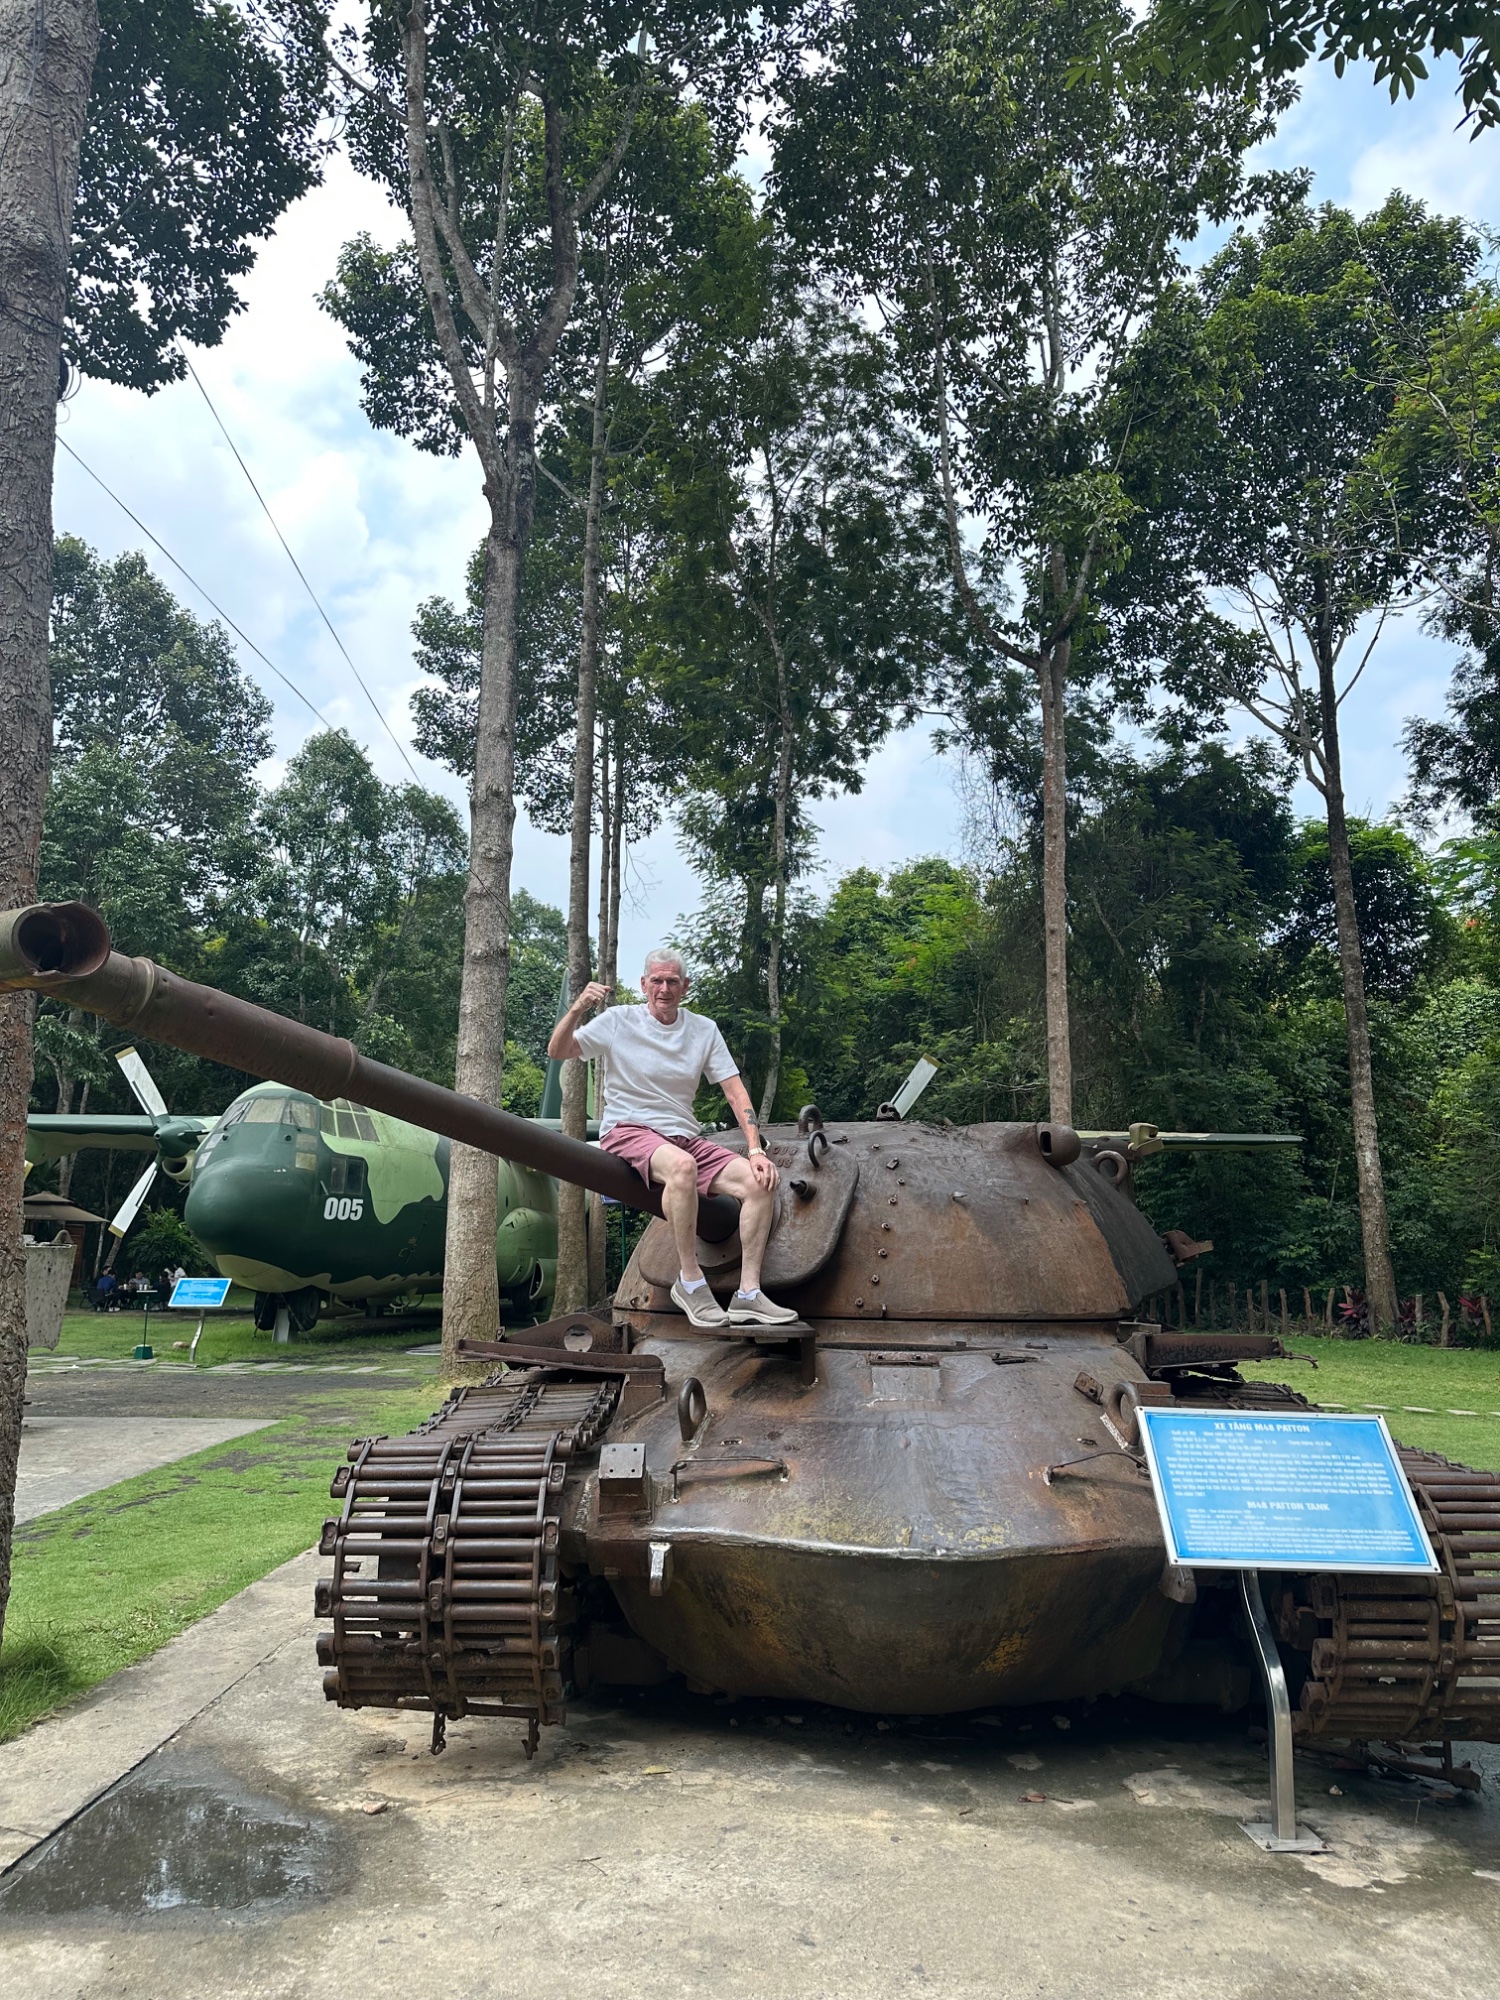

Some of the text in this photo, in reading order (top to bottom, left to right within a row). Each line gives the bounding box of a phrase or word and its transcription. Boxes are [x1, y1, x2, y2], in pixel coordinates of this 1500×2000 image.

[324, 1197, 363, 1220] 005
[1214, 1421, 1310, 1433] XE TĂNG M48 PATTON
[1247, 1501, 1330, 1511] M48 PATTON TANK
